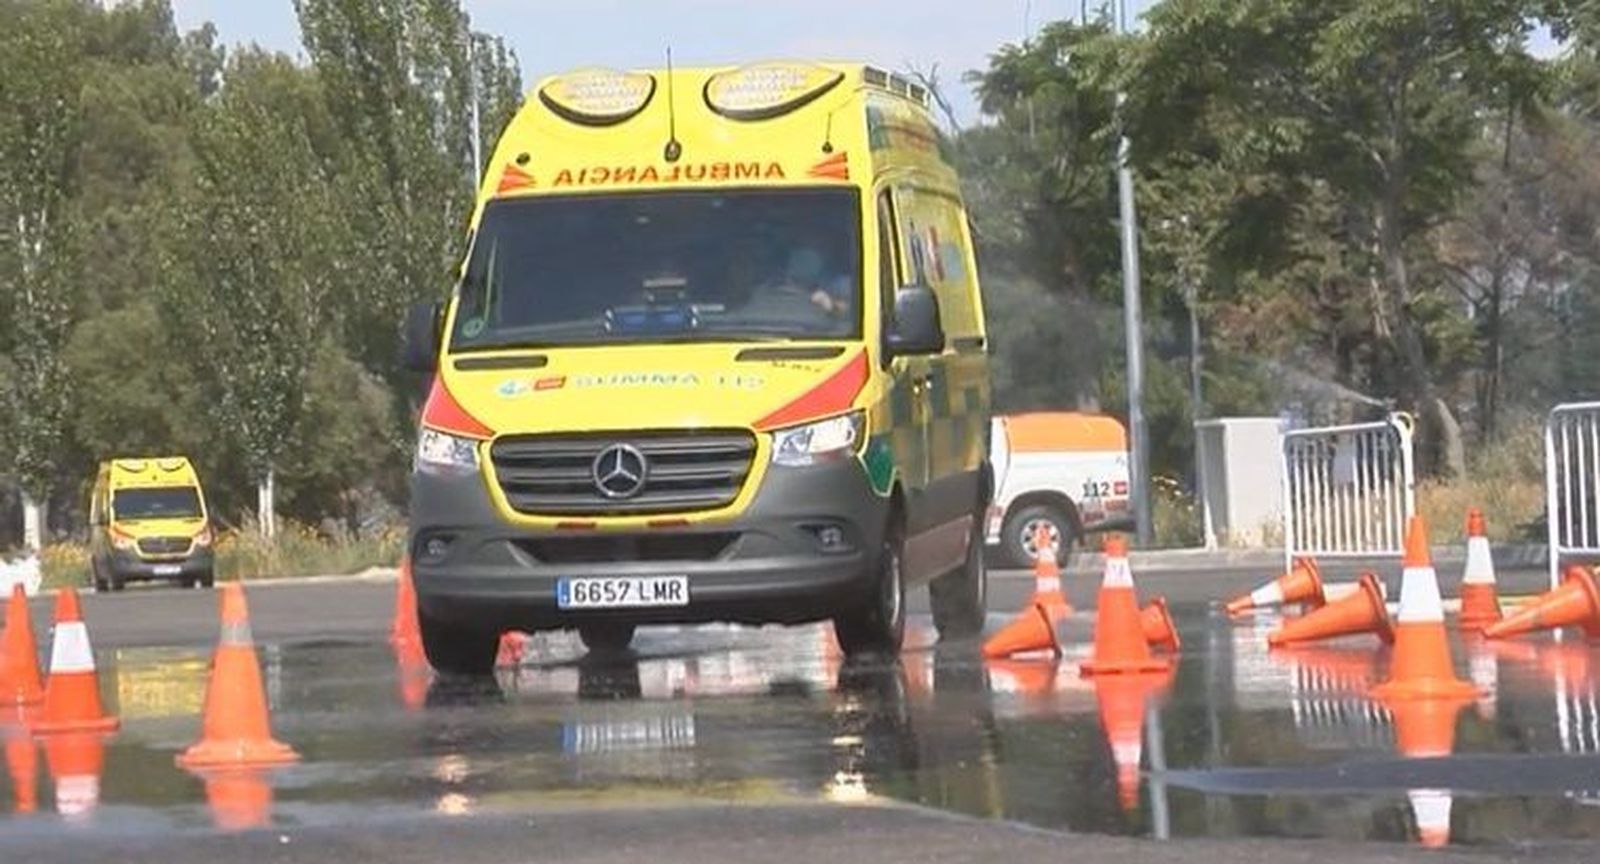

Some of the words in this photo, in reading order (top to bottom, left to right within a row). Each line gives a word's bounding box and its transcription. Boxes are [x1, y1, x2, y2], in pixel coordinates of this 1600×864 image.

[1082, 481, 1111, 497] 112
[573, 580, 631, 603] 6657
[639, 579, 682, 602] LMR
